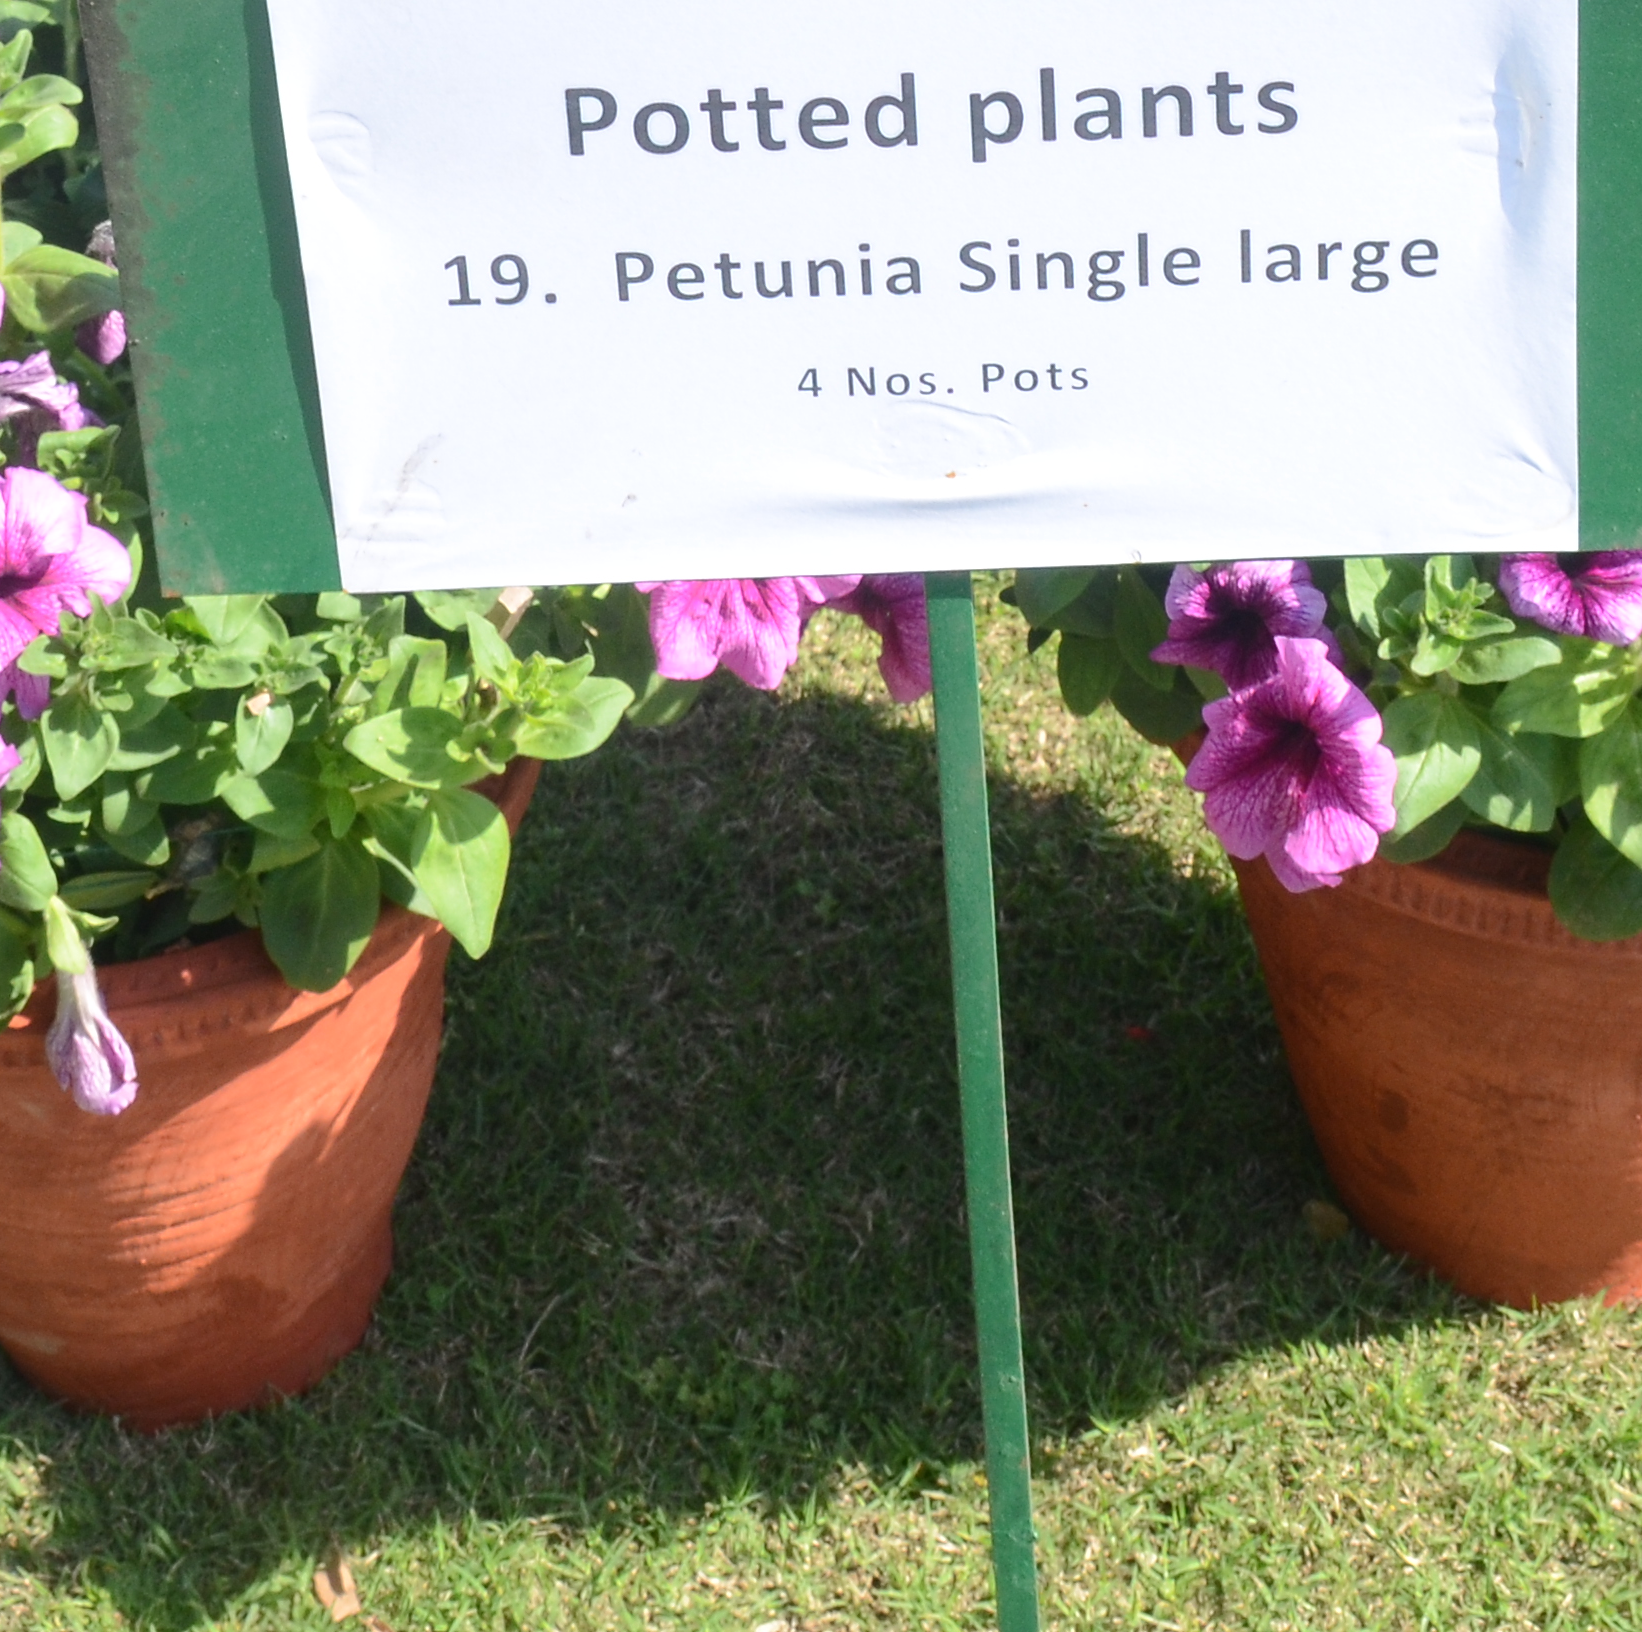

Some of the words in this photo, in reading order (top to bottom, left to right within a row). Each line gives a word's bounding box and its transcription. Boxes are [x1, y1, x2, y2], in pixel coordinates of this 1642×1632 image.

[564, 72, 918, 156] Potted
[969, 67, 1298, 163] plants
[443, 254, 558, 306] 19.
[615, 243, 921, 302] Petunia
[959, 232, 1201, 302] Single
[1240, 229, 1439, 293] large
[797, 368, 822, 397] 4
[847, 366, 954, 397] Nos.
[982, 363, 1089, 393] Pots
